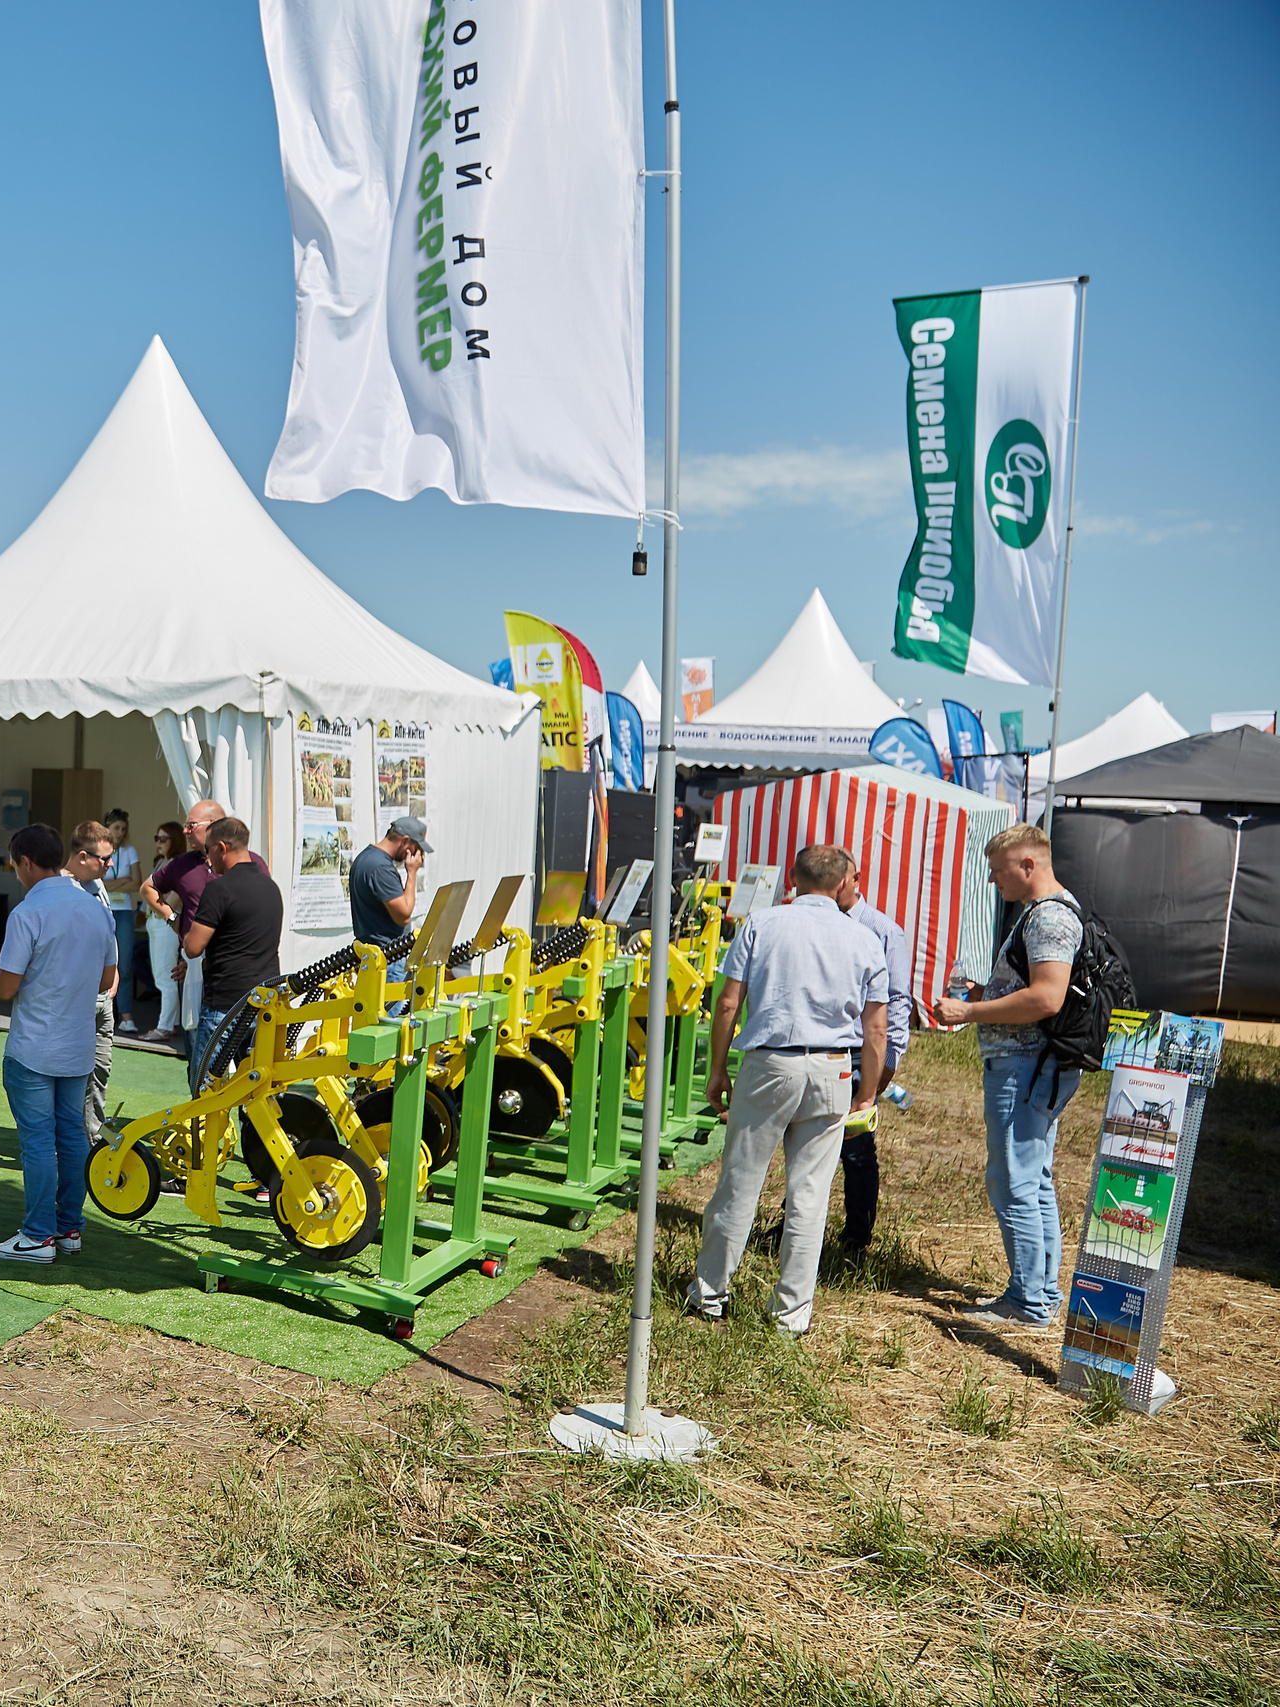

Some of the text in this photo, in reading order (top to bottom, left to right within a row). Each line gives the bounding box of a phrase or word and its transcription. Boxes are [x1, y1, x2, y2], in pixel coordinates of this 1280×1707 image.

[418, 0, 453, 372] СКИЙ ФЕРМЕР
[452, 0, 493, 361] ОВЫЙ ДОМ
[909, 316, 955, 475] Семена
[646, 729, 709, 739] ОТЛЕНИЕ
[719, 732, 818, 743] ВОДОСНАБЖЕНИЕ
